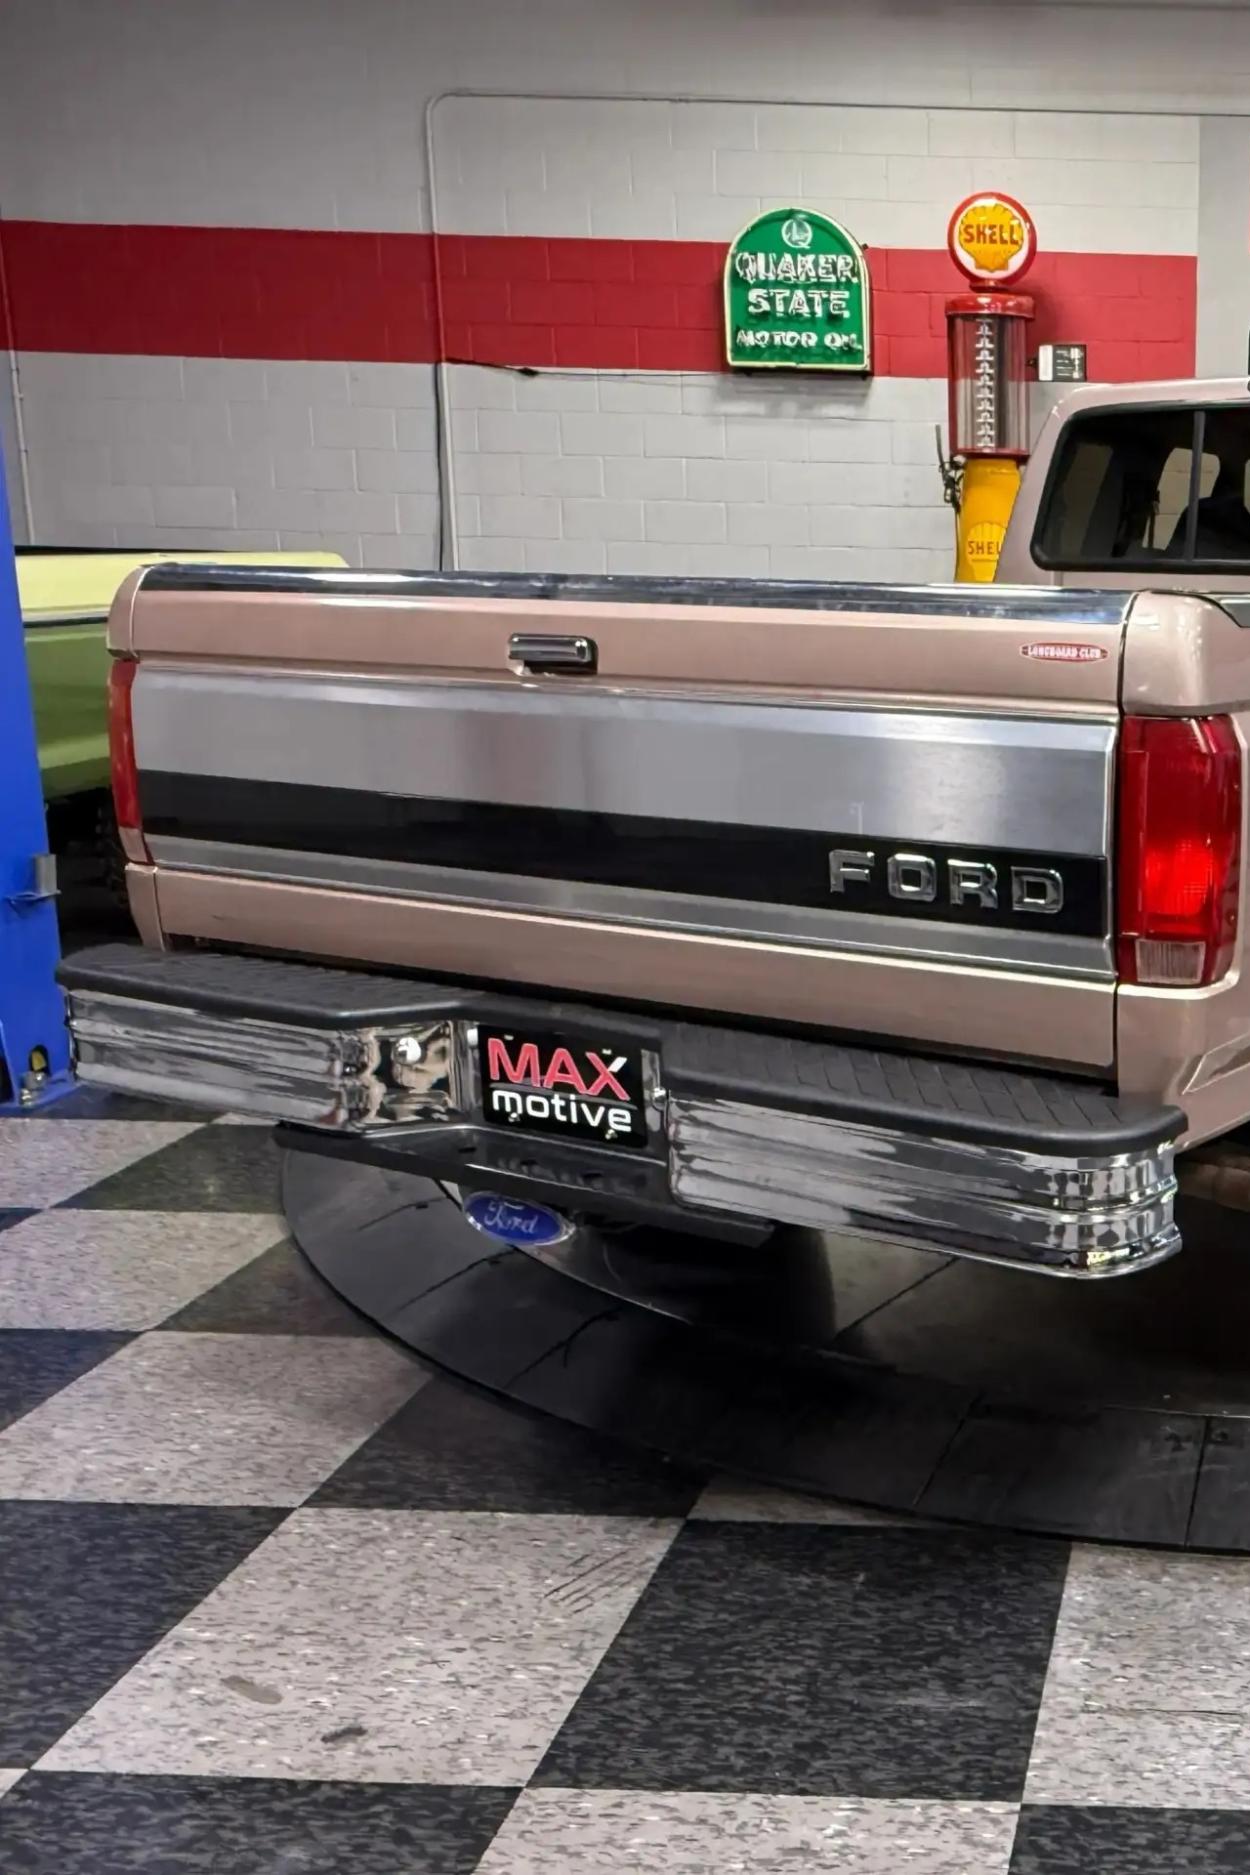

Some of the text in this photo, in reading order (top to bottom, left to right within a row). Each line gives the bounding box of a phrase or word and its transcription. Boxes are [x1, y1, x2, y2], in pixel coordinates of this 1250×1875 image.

[963, 223, 1019, 246] SHELL
[735, 251, 859, 284] QUAKER
[748, 288, 850, 318] STATE
[736, 330, 818, 348] MOTOR
[829, 849, 1064, 914] FORD
[488, 1037, 631, 1102] MAX
[493, 1090, 632, 1132] motive
[484, 1201, 538, 1235] Ford
